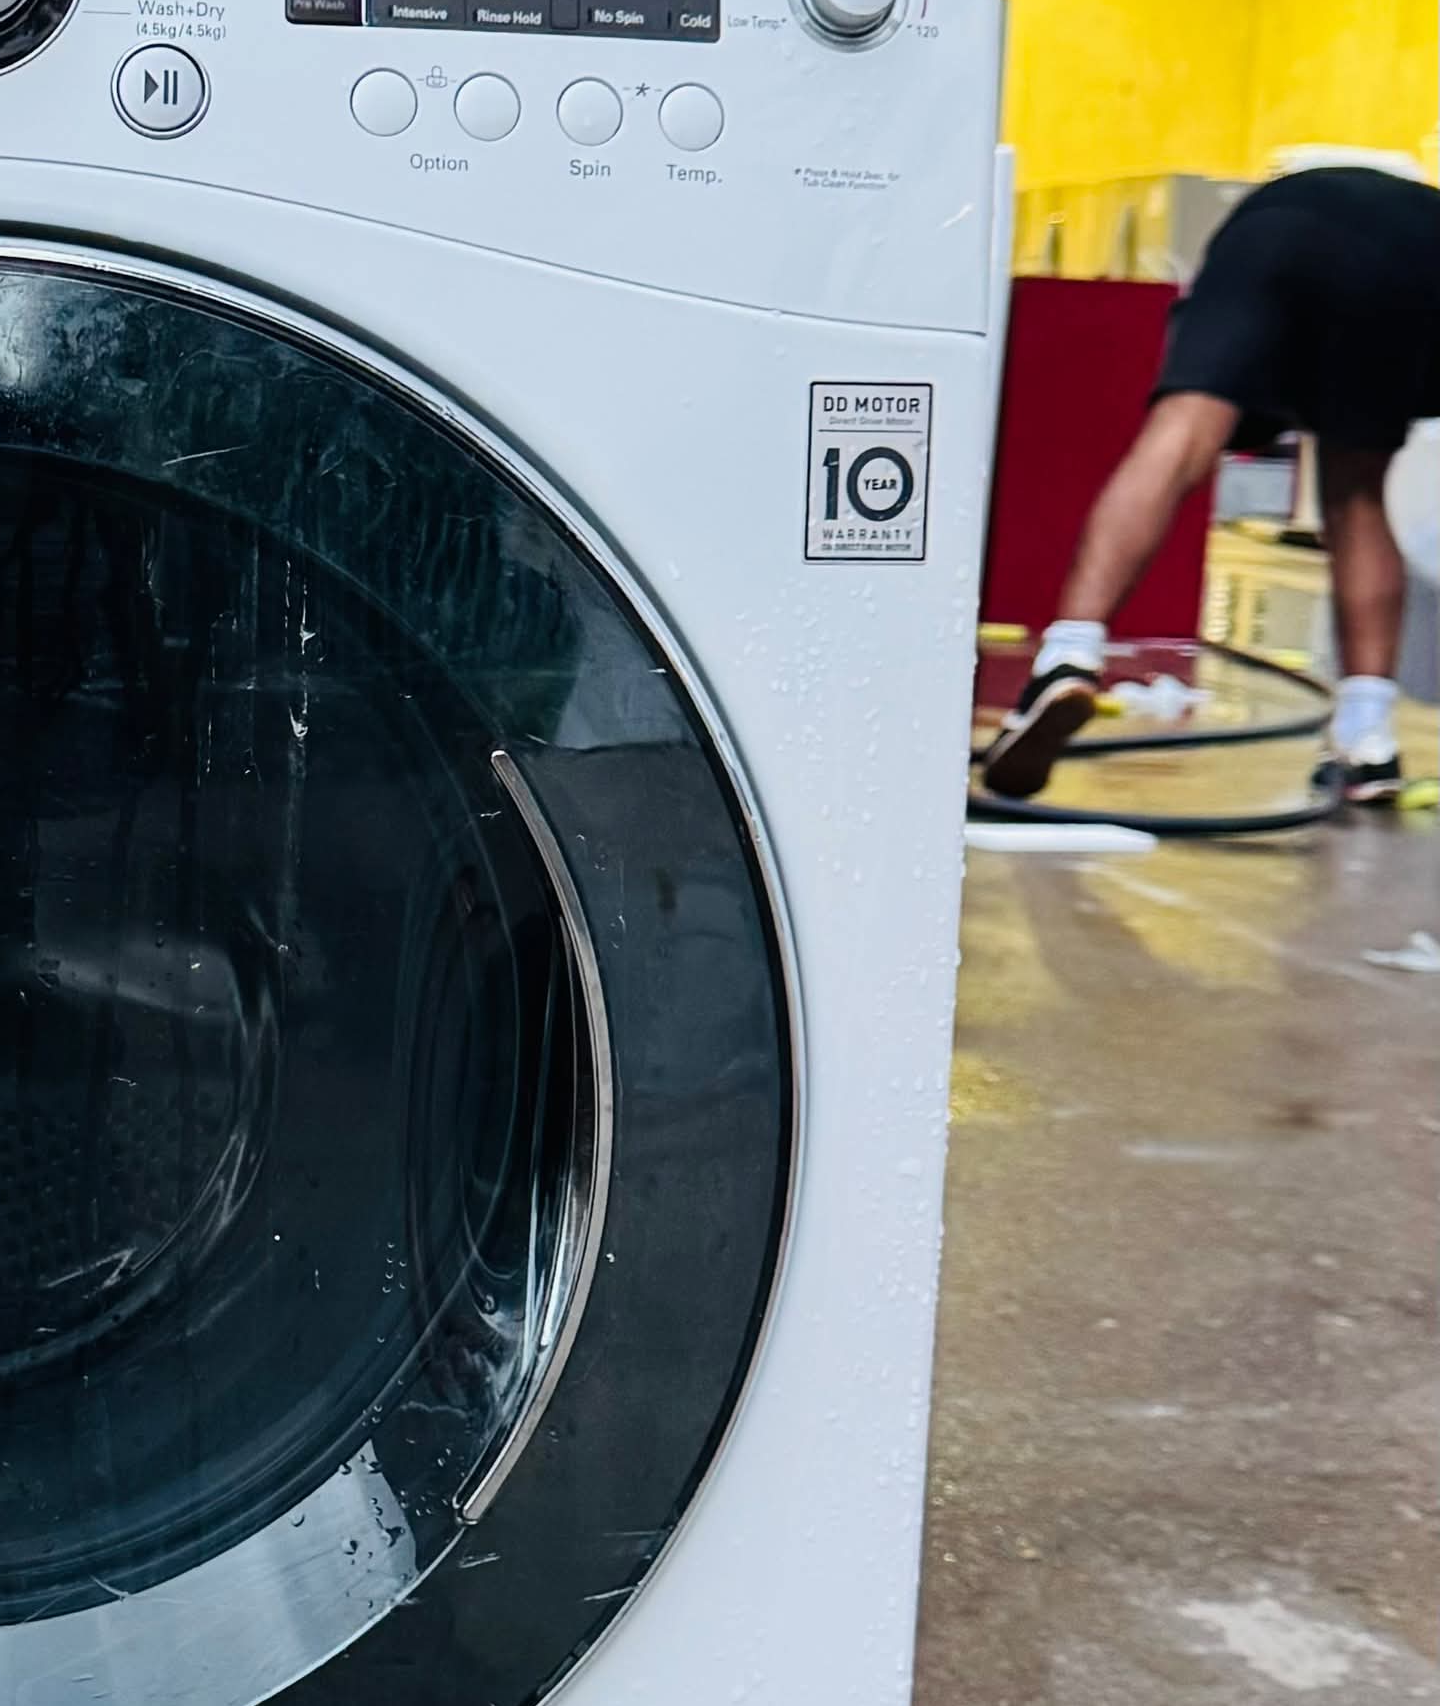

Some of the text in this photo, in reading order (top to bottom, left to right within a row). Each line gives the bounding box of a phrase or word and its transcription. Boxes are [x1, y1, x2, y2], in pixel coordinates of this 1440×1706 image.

[137, 0, 225, 21] Wash+Dry
[392, 4, 448, 20] Intensive
[476, 8, 542, 25] Rinse Hold
[594, 8, 645, 27] No Spin
[679, 13, 711, 28] Cold
[916, 26, 939, 38] 120
[410, 153, 469, 172] Option
[569, 159, 611, 178] Spin
[666, 164, 723, 184] Temp.
[823, 396, 920, 413] DD MOTOR
[823, 446, 914, 522] 10
[863, 478, 897, 491] YEAR
[822, 528, 911, 541] WARRANTY
